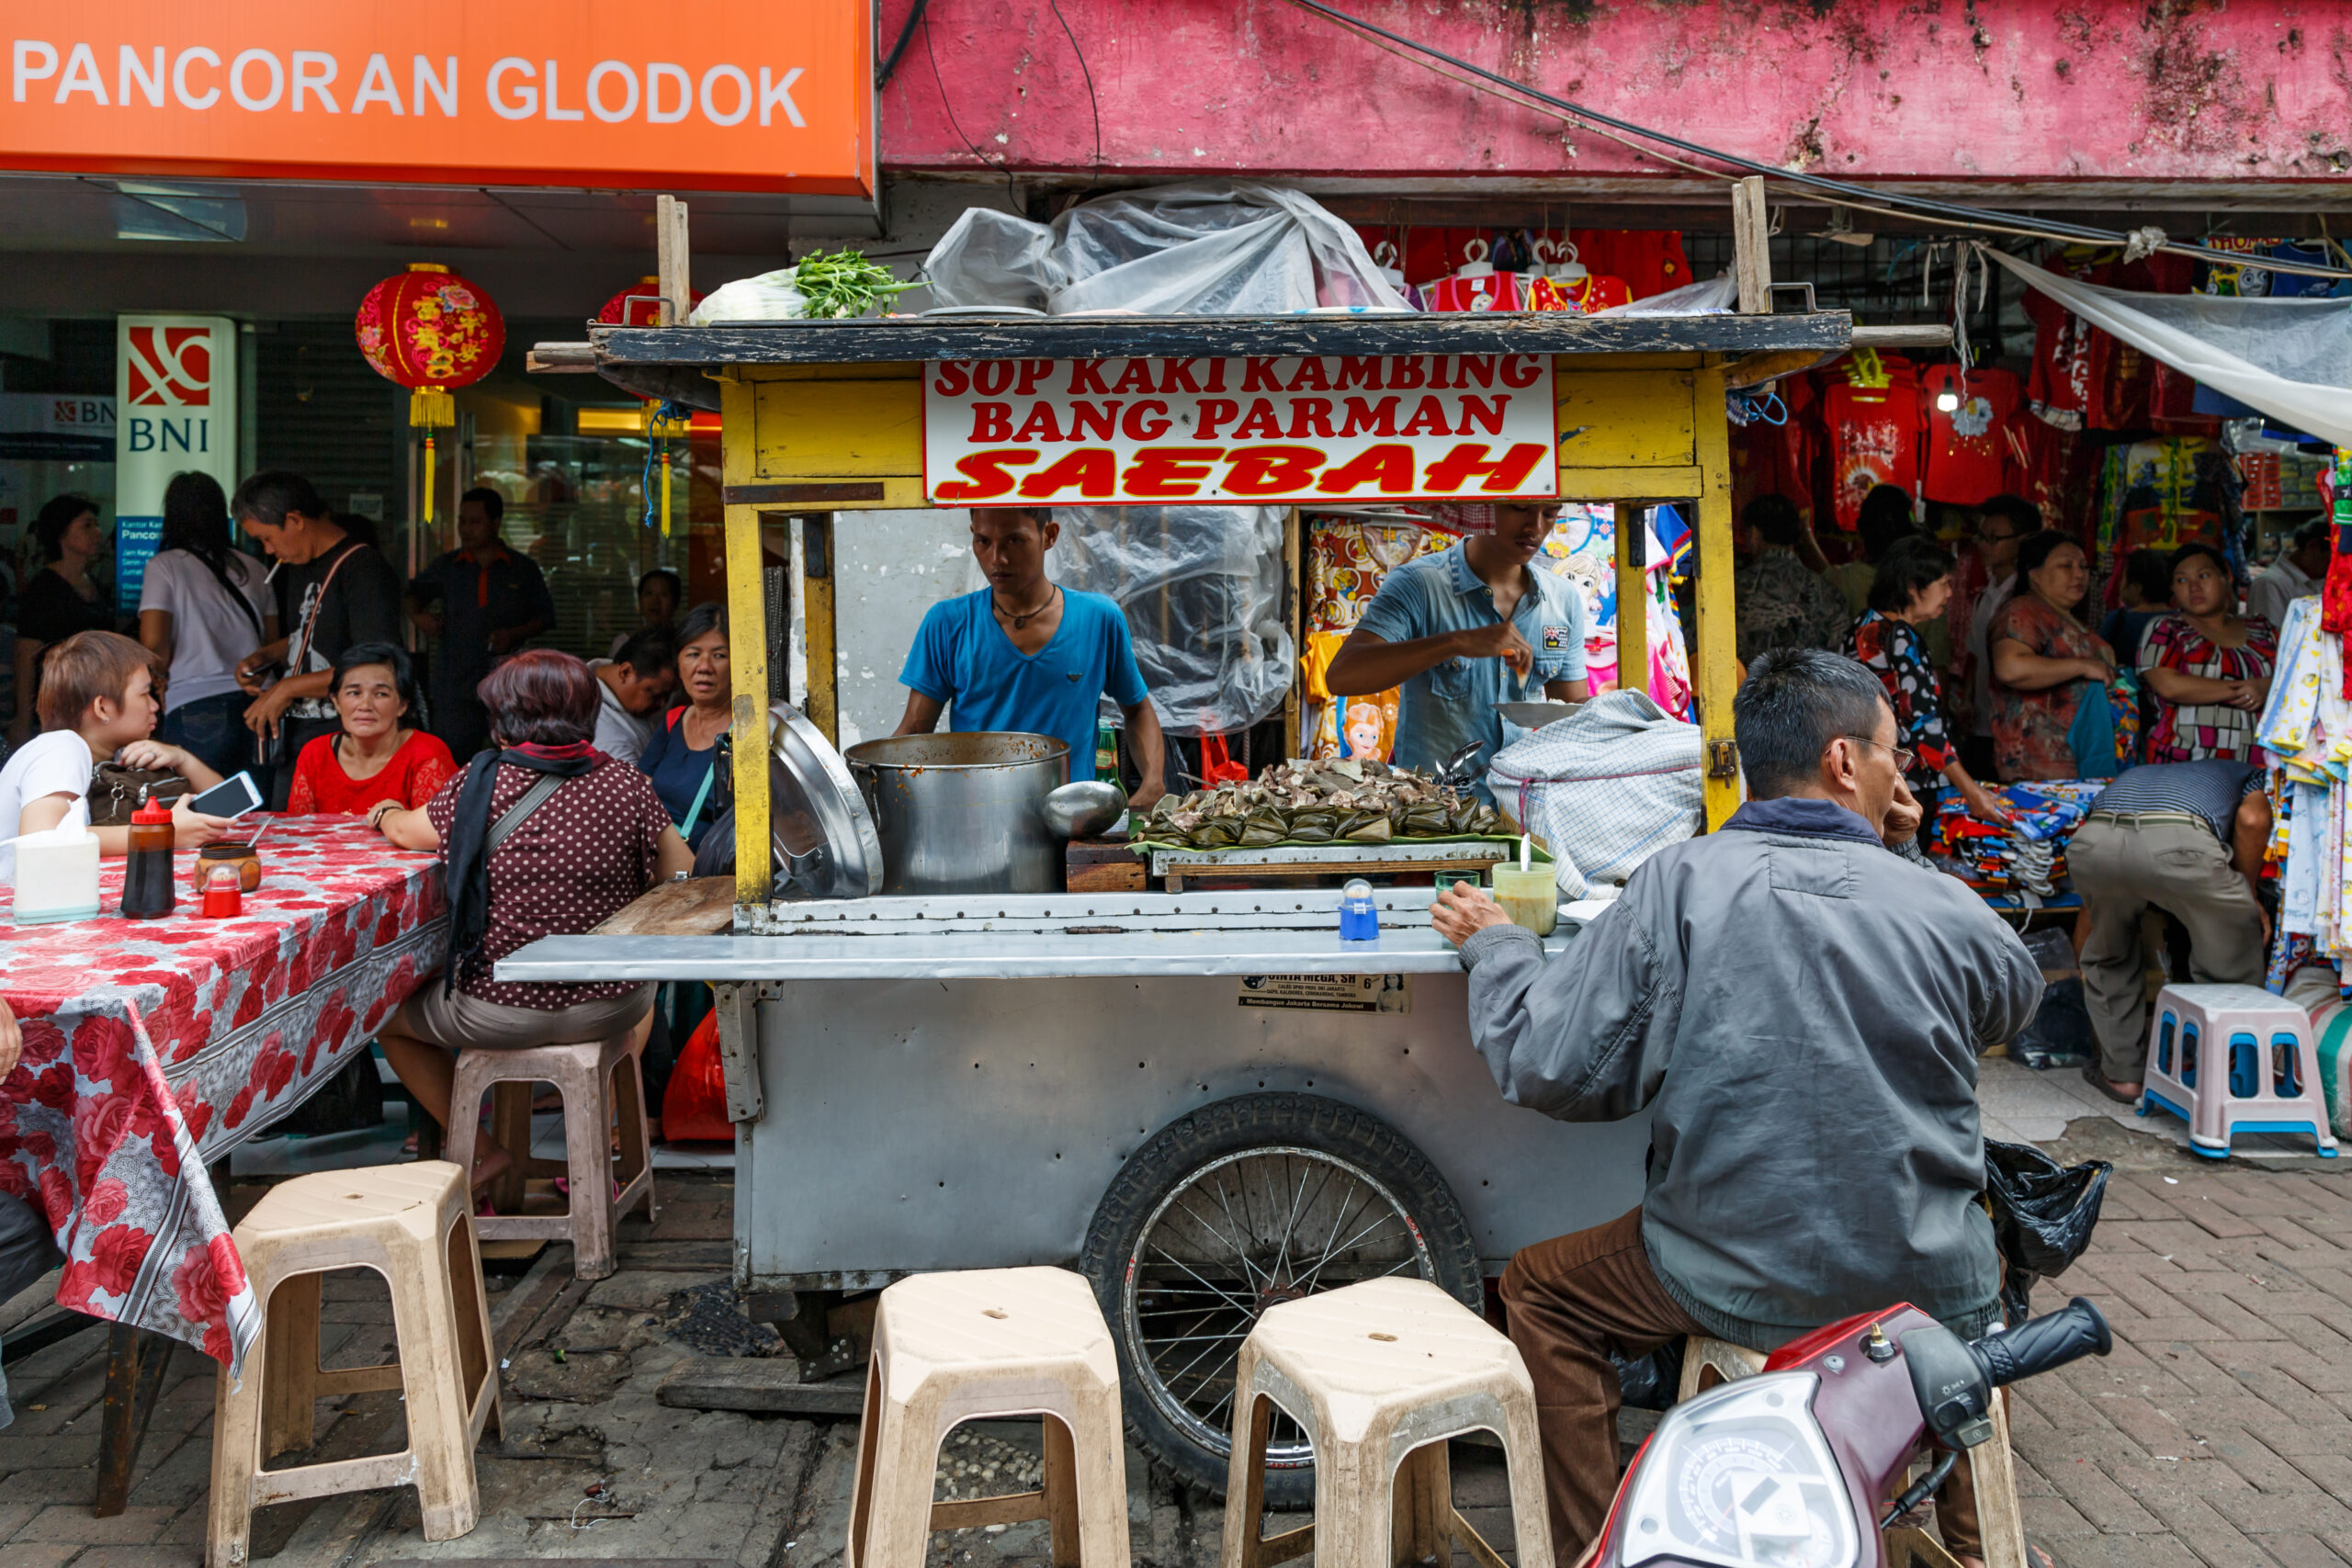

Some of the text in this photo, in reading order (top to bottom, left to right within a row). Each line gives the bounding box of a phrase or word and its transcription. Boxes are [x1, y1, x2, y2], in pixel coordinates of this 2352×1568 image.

[12, 39, 808, 129] PANCORAN GLODOK
[934, 355, 1544, 397] SOP KAKI KAMBING
[129, 418, 209, 453] BNI
[967, 393, 1513, 443] BANG PARMAN
[933, 443, 1550, 501] SAEBAH
[1246, 998, 1285, 1006] Membangun
[1363, 977, 1372, 989] 6
